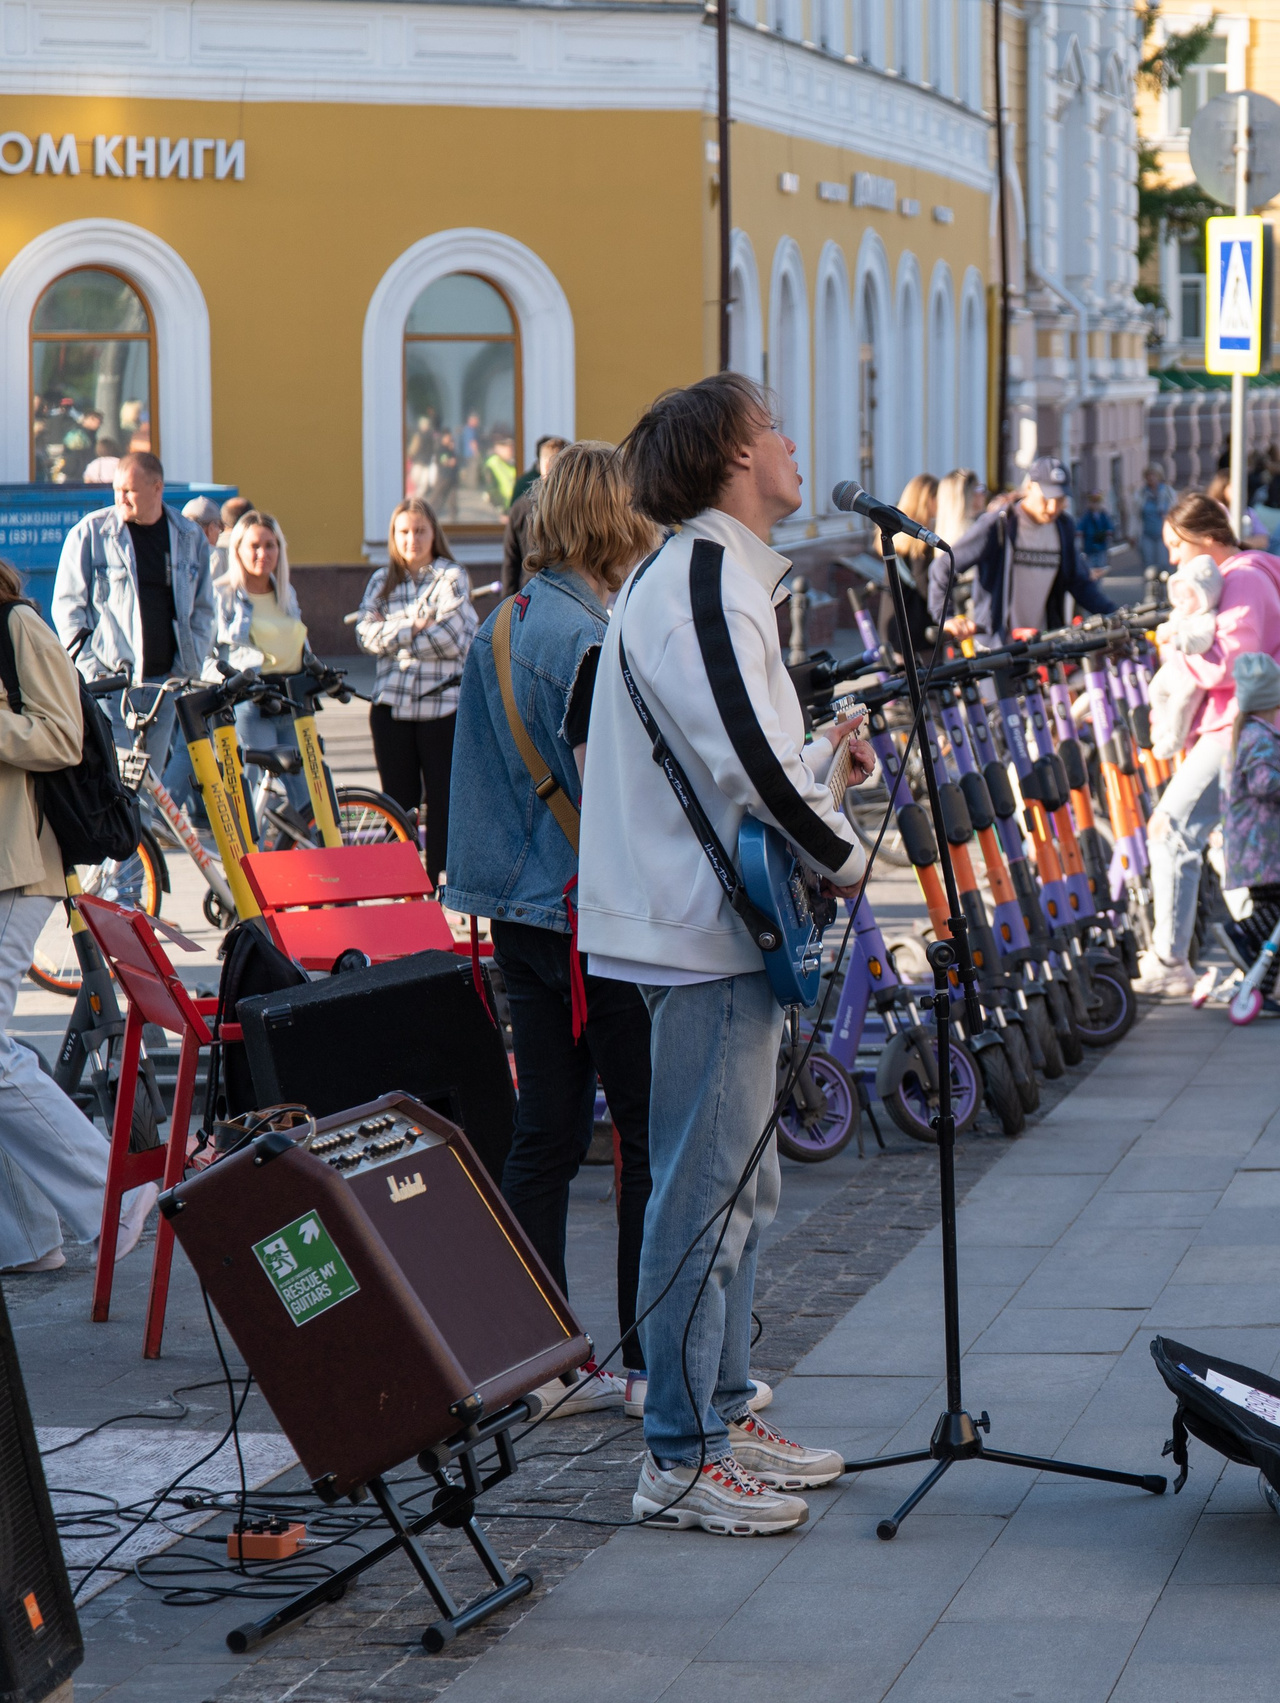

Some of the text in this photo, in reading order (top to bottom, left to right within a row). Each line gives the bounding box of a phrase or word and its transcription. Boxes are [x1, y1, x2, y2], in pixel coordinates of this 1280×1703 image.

[94, 134, 246, 181] КНИГИ
[623, 669, 649, 724] Harley Benton
[221, 737, 239, 795] WHOOSH
[302, 728, 320, 781] WHOOSH
[211, 782, 236, 844] WHOOSH
[672, 777, 690, 809] Benton
[154, 785, 212, 870] LUCKY BIKE
[704, 843, 720, 869] Harley
[282, 1271, 322, 1302] RESCUE
[319, 1261, 338, 1280] MY
[290, 1283, 332, 1315] GUITARS
